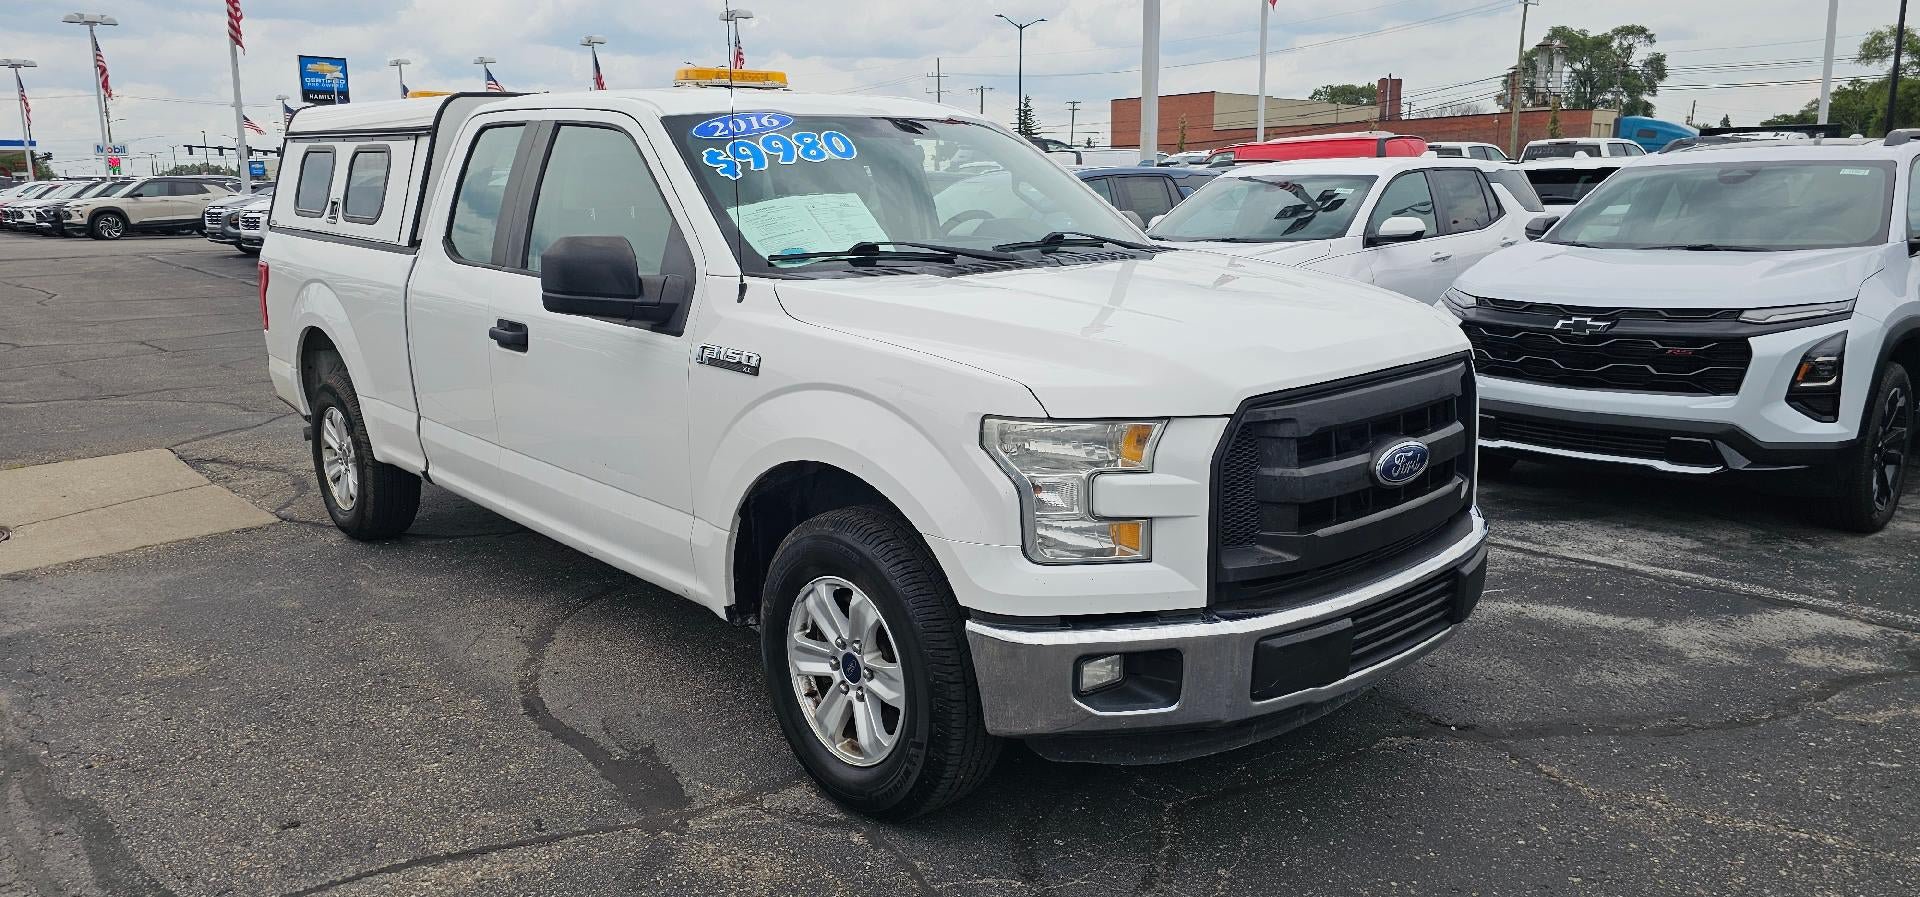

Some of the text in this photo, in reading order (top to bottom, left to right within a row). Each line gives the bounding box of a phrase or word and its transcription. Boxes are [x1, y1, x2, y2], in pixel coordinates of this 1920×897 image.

[708, 114, 780, 137] 2016
[96, 145, 126, 153] Mobil
[702, 130, 857, 180] $9980
[1391, 450, 1421, 477] Ford
